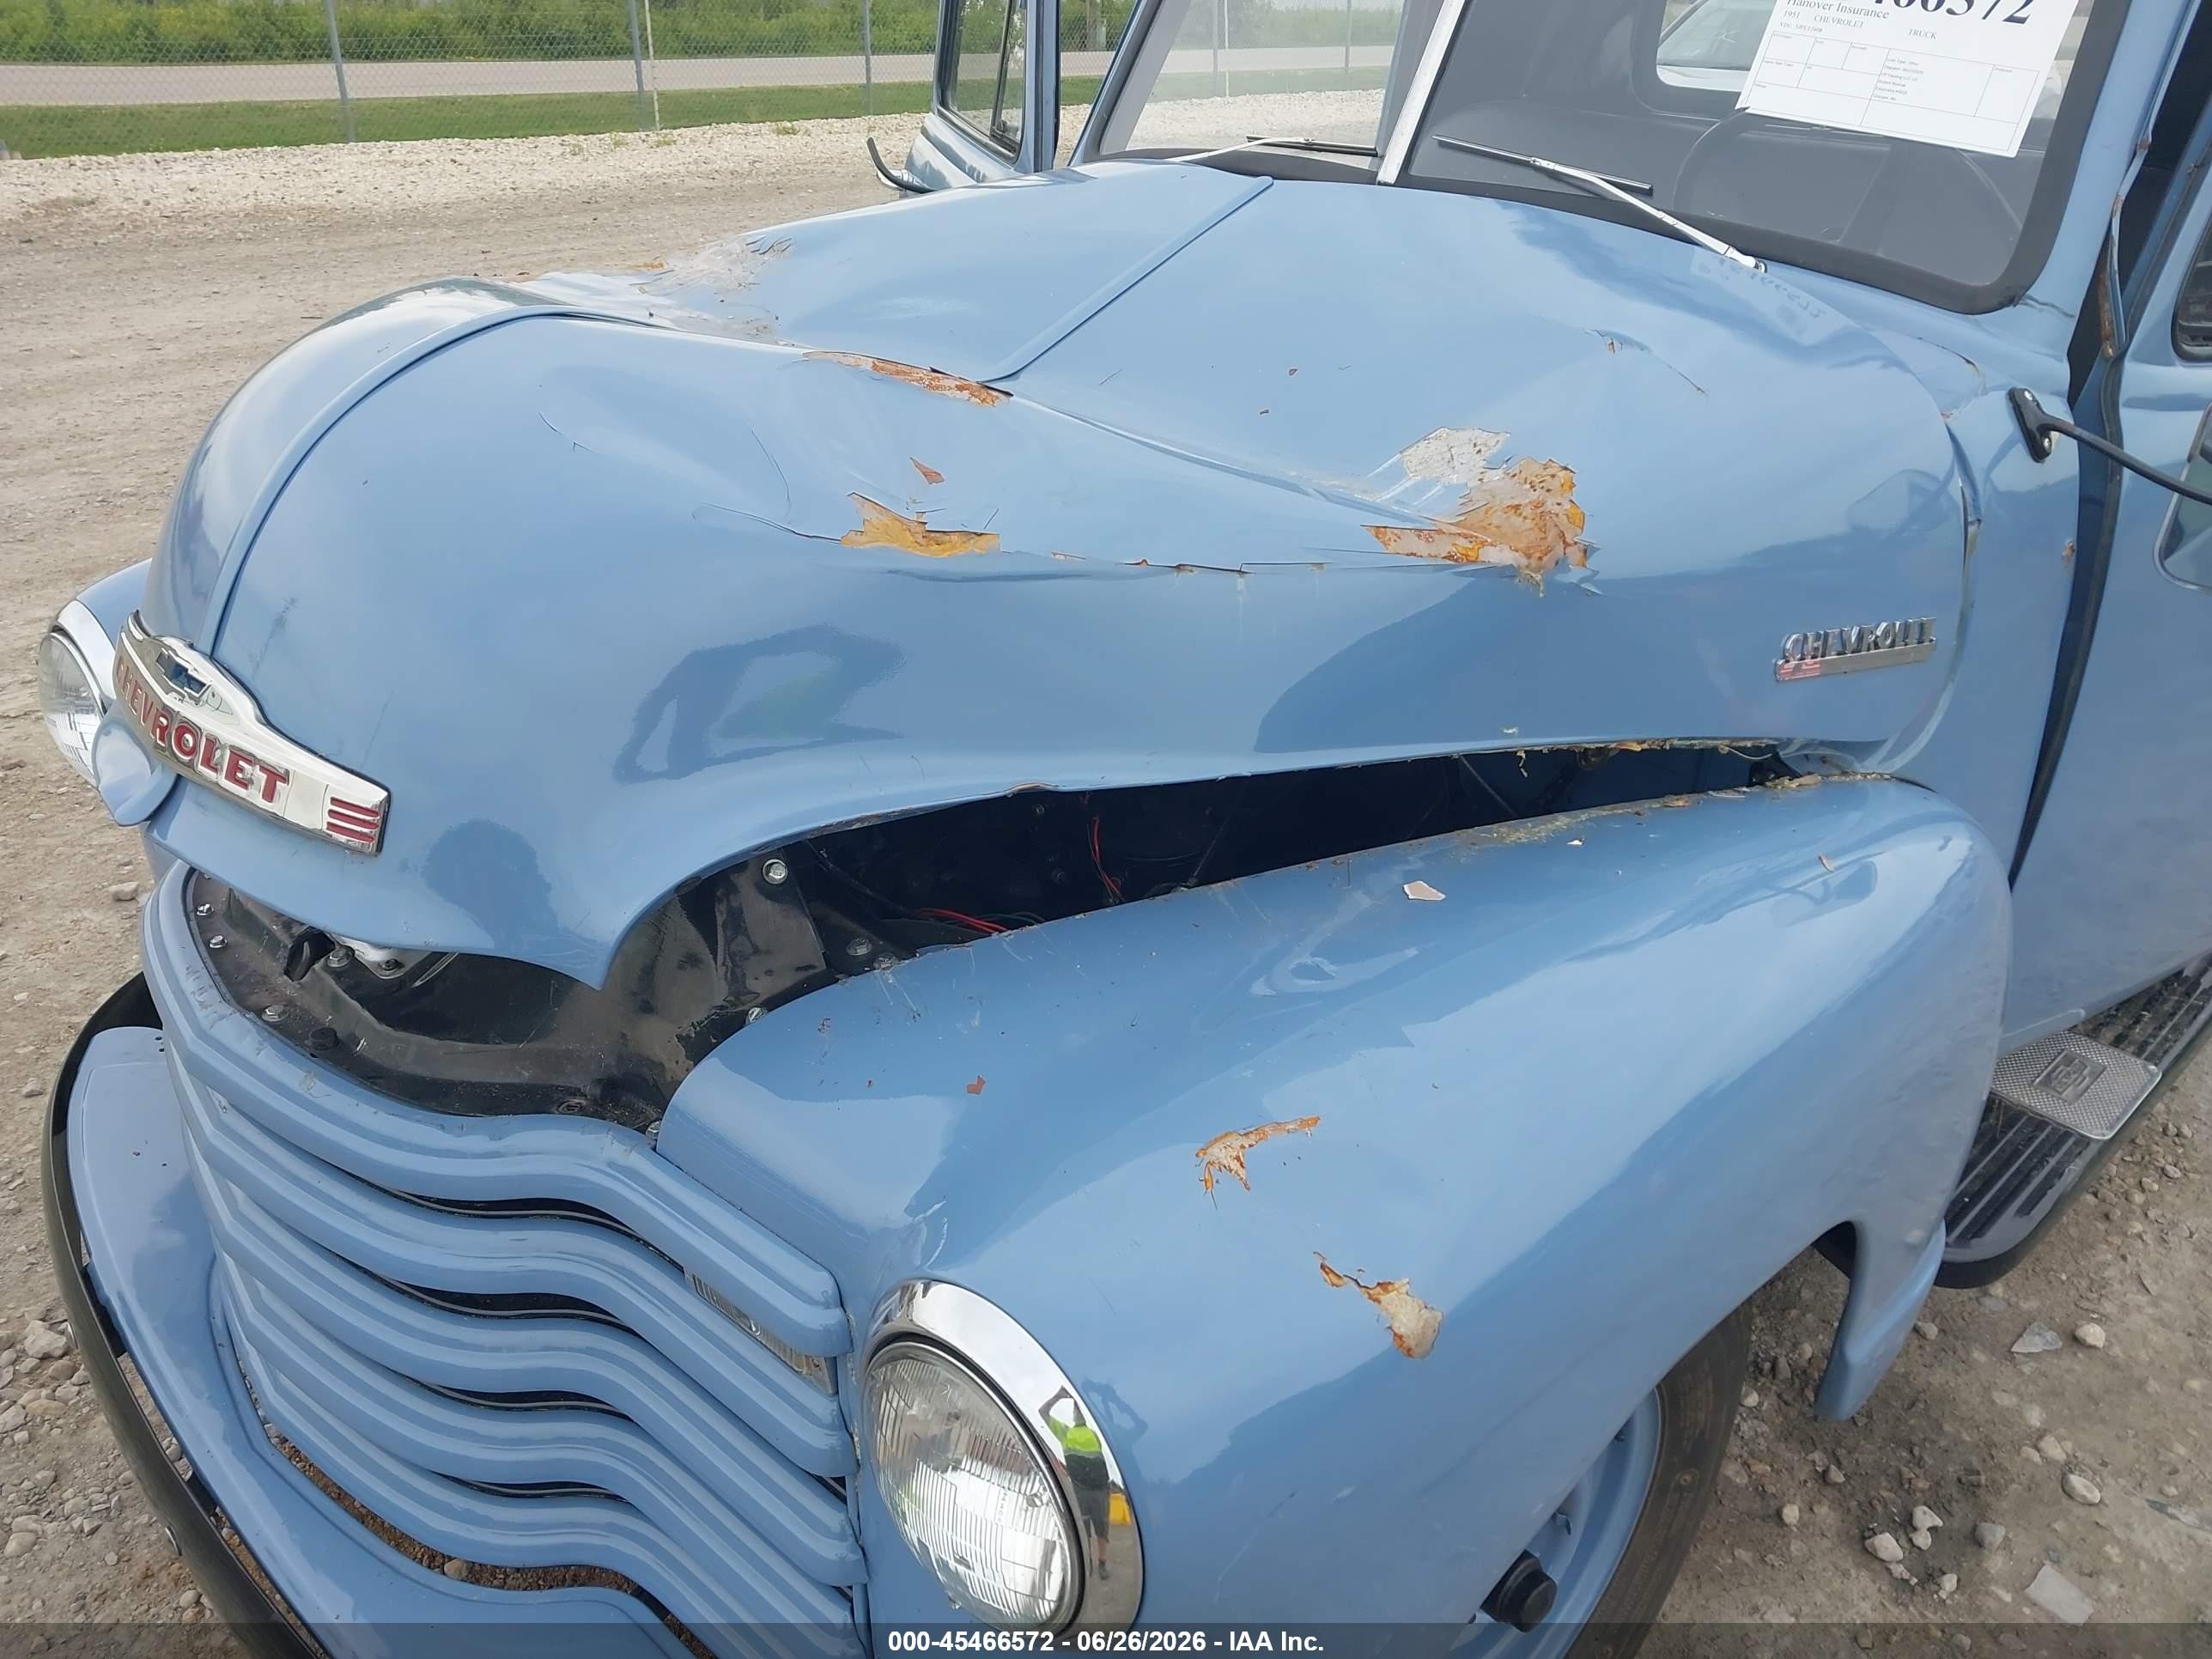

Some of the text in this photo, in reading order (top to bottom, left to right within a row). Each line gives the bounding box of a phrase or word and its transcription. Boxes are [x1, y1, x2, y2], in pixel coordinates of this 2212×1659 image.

[1784, 10, 1937, 40] 1951 CHEVROLET TRUCK
[1837, 2, 1890, 19] Insurance
[1782, 617, 1937, 663] CHEVROLET
[115, 654, 291, 805] CHEVROLET
